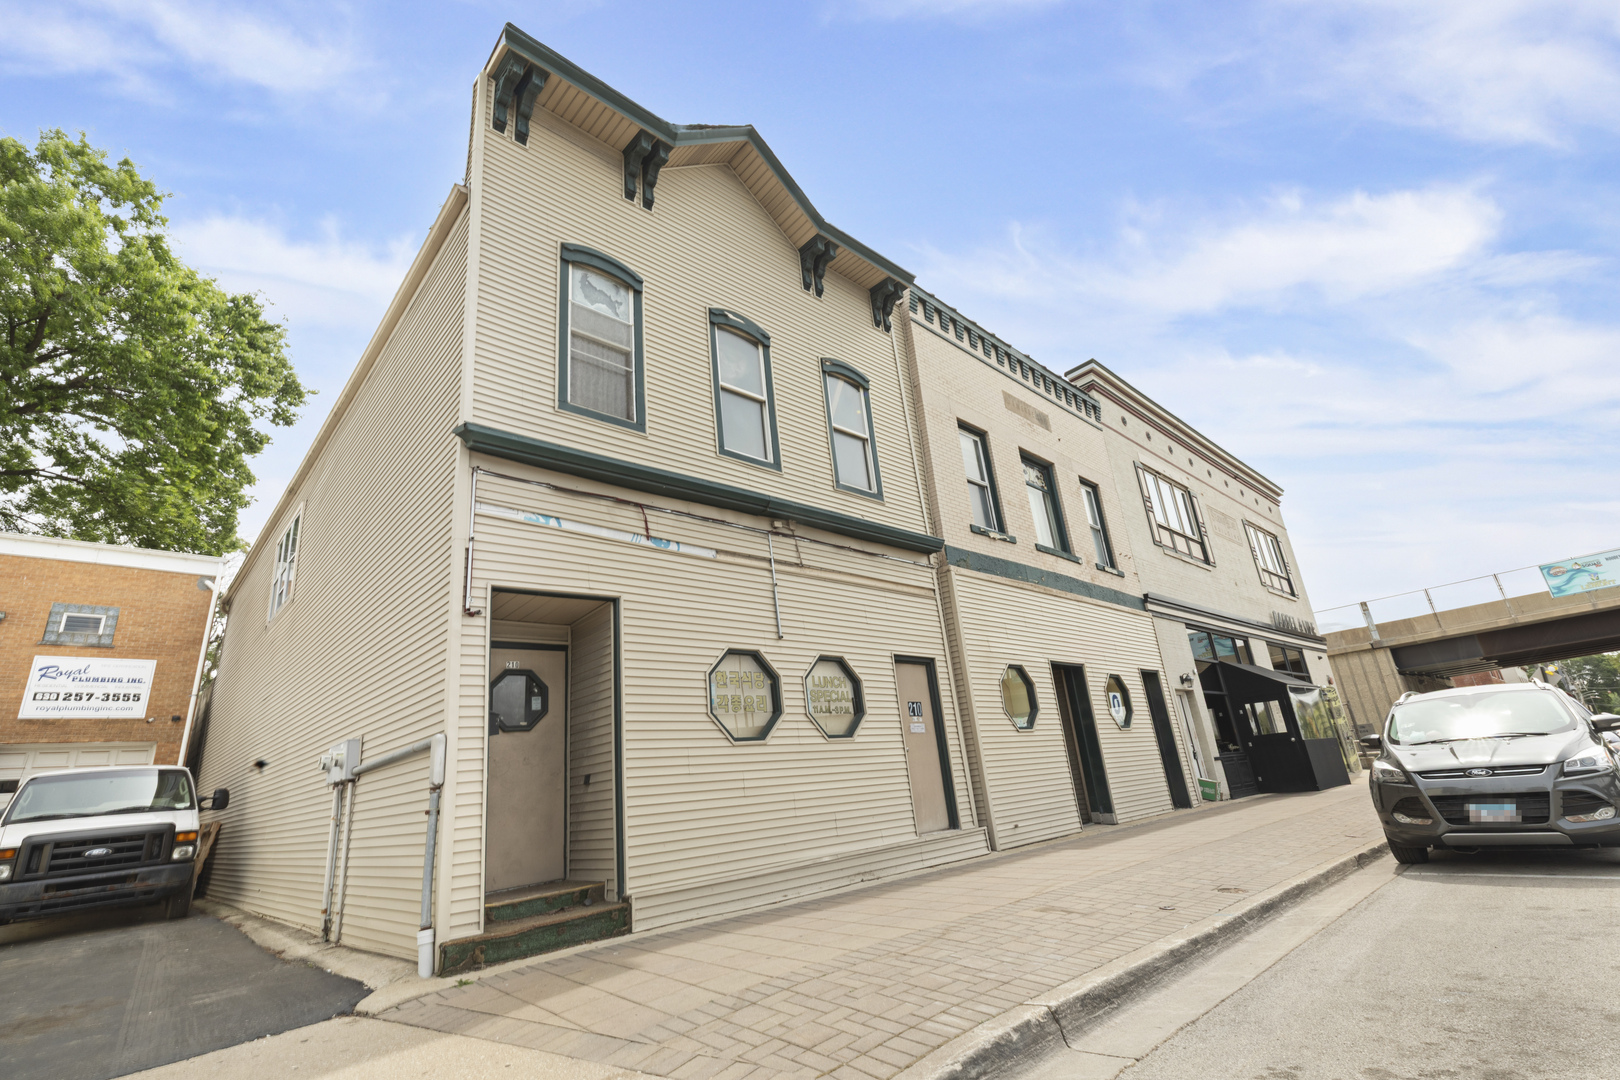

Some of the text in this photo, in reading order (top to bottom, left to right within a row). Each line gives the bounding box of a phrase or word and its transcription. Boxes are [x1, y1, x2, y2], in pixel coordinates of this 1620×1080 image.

[38, 664, 91, 681] Royal
[715, 670, 765, 689] 한국식당
[811, 675, 847, 689] LUNCH
[62, 692, 141, 702] 257-3555
[809, 689, 851, 703] SPECIAL
[717, 695, 768, 713] 각종요리
[907, 702, 922, 716] 210
